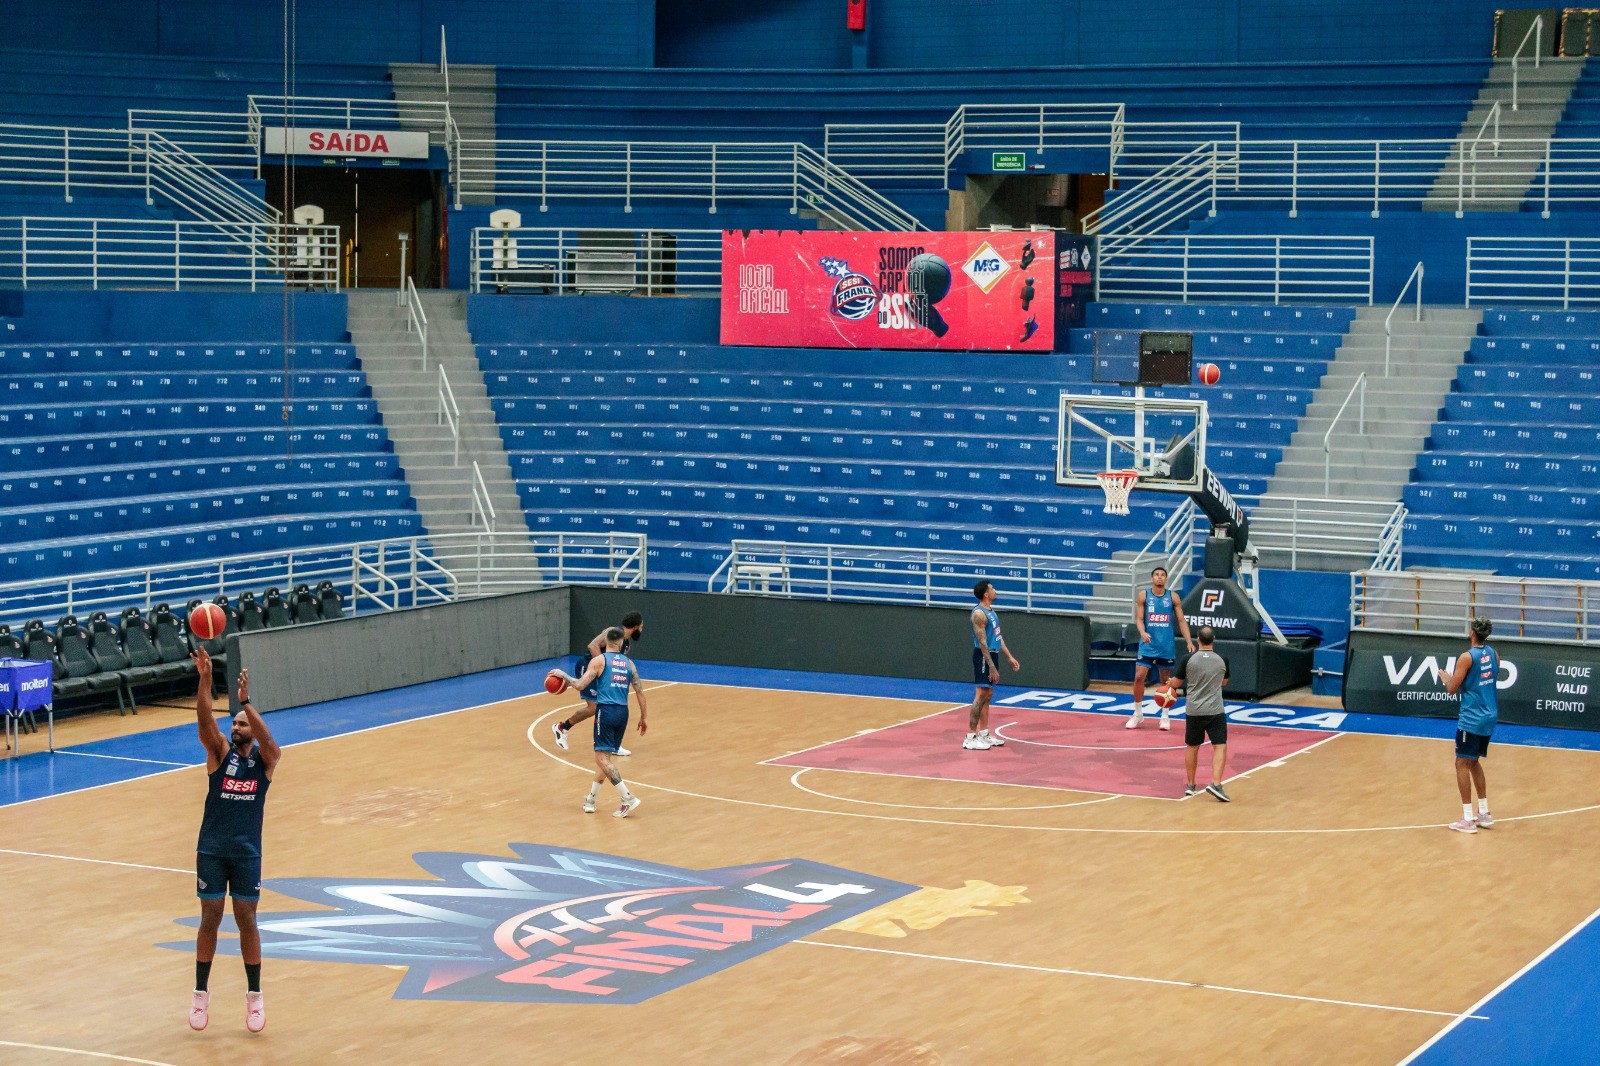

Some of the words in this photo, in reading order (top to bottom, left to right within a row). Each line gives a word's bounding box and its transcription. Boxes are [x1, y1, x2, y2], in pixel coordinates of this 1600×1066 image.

[739, 264, 774, 288] LOJA
[841, 277, 861, 290] SESI
[739, 288, 790, 314] OFICIAL
[1164, 308, 1172, 316] 12
[1230, 309, 1238, 317] 14
[1325, 312, 1333, 320] 17
[1498, 313, 1507, 321] 21
[1531, 314, 1541, 322] 22
[1565, 315, 1576, 323] 23
[1243, 336, 1252, 344] 52
[550, 348, 559, 356] 77
[1507, 370, 1520, 378] 107
[1579, 371, 1593, 379] 109
[269, 376, 282, 384] 274
[298, 376, 311, 384] 275
[842, 381, 853, 389] 144
[512, 429, 525, 437] 242
[543, 429, 556, 437] 243
[576, 429, 589, 437] 244
[675, 430, 688, 438] 247
[1447, 428, 1460, 436] 217
[1553, 431, 1568, 439] 220
[263, 434, 275, 442] 422
[313, 433, 326, 441] 424
[1431, 458, 1448, 466] 270
[1468, 460, 1483, 468] 271
[1504, 461, 1520, 469] 272
[1544, 462, 1560, 470] 273
[1581, 464, 1597, 472] 274
[935, 470, 948, 478] 307
[627, 488, 640, 496] 347
[660, 489, 672, 497] 348
[1419, 489, 1433, 497] 321
[1452, 490, 1468, 498] 322
[784, 494, 796, 502] 352
[817, 495, 829, 503] 353
[848, 496, 860, 504] 354
[1492, 493, 1507, 501] 323
[1528, 494, 1543, 502] 324
[1570, 496, 1587, 504] 325
[947, 501, 959, 509] 357
[829, 527, 841, 535] 401
[860, 528, 872, 536] 402
[1443, 524, 1458, 532] 371
[1478, 526, 1493, 534] 372
[1518, 527, 1533, 535] 373
[1556, 528, 1572, 536] 374
[894, 530, 907, 538] 403
[1028, 537, 1041, 545] 407
[1096, 540, 1109, 548] 409
[711, 553, 724, 561] 443
[744, 554, 757, 562] 444
[842, 559, 855, 567] 447
[941, 565, 955, 573] 450
[974, 567, 987, 575] 451
[1043, 571, 1057, 579] 453
[1077, 572, 1091, 580] 454
[1149, 614, 1168, 622] SESI
[1184, 615, 1238, 629] FREEWAY
[1555, 665, 1591, 678] CLIQUE
[21, 677, 49, 692] molten
[1556, 682, 1588, 695] VALID
[1396, 691, 1458, 702] CERTIFICADORA
[1536, 699, 1543, 710] E
[1545, 700, 1585, 713] PRONTO
[225, 779, 256, 791] SESI
[220, 792, 256, 800] NETSHOES
[494, 902, 833, 996] FINAL
